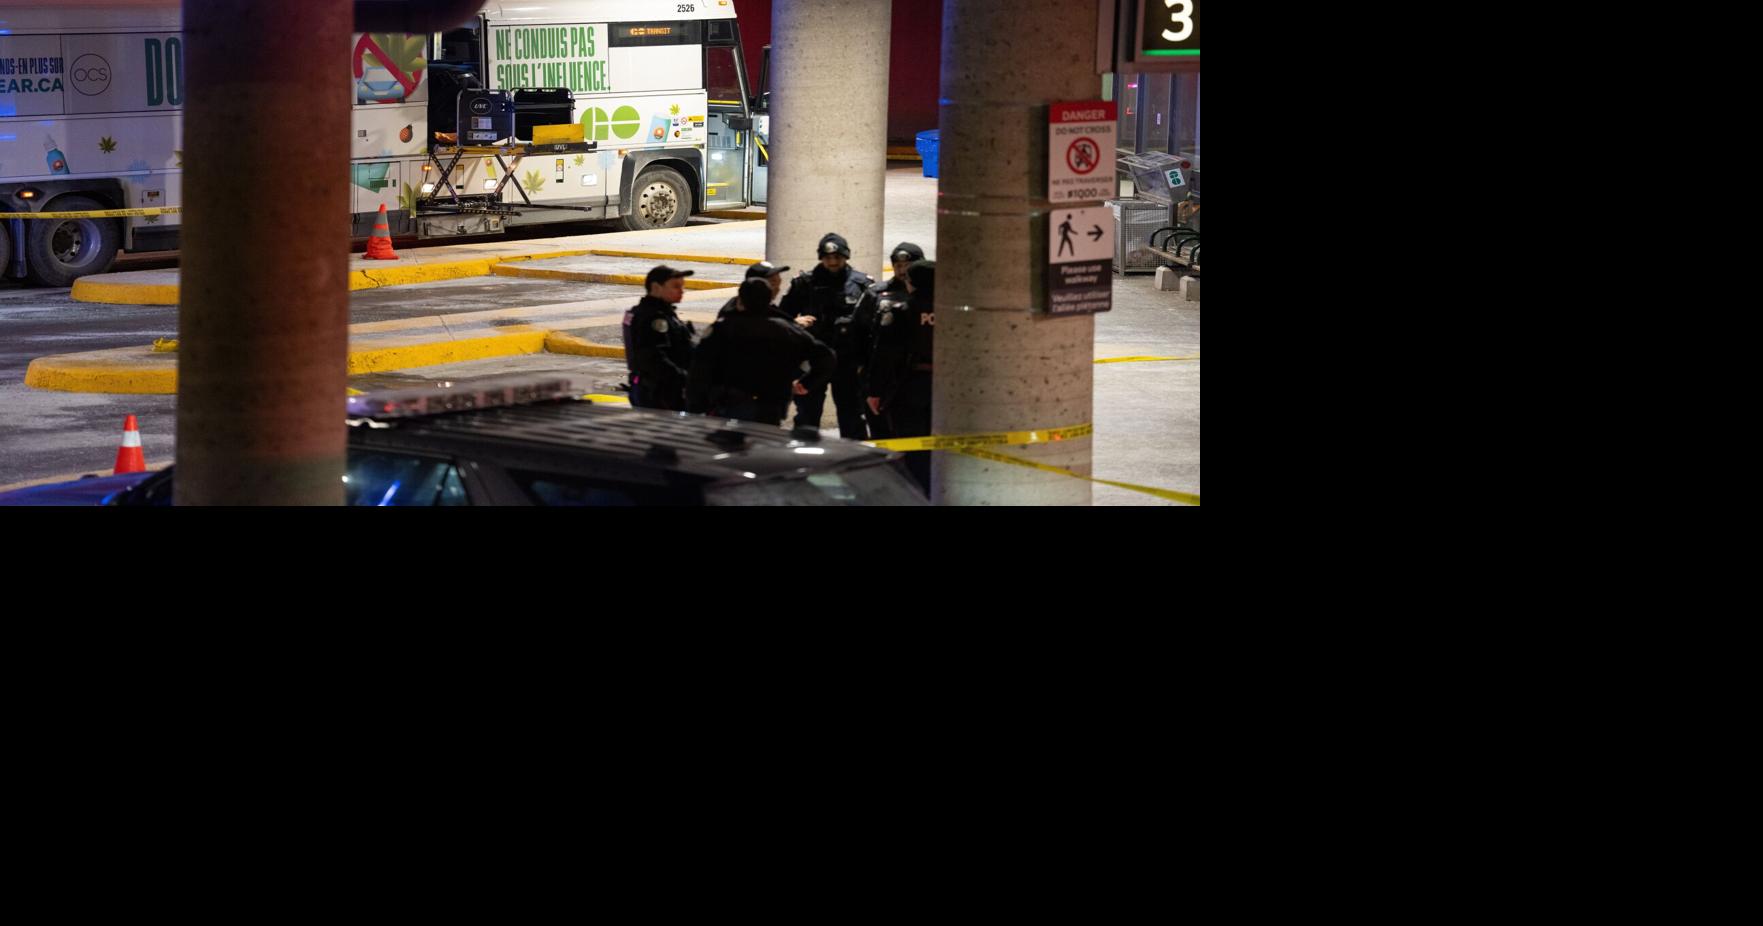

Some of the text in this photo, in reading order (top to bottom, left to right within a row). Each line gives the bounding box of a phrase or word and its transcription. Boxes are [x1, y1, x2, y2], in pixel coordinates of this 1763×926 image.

[677, 4, 695, 13] 2526
[1161, 0, 1193, 42] 3
[496, 26, 595, 60] NE CONDUIS PAS
[29, 57, 48, 74] PLUS
[49, 56, 64, 73] SUR
[74, 68, 108, 82] OCS
[496, 64, 529, 90] SOUS
[1061, 109, 1106, 121] DANGER
[1055, 125, 1112, 135] DO NOT CROSS
